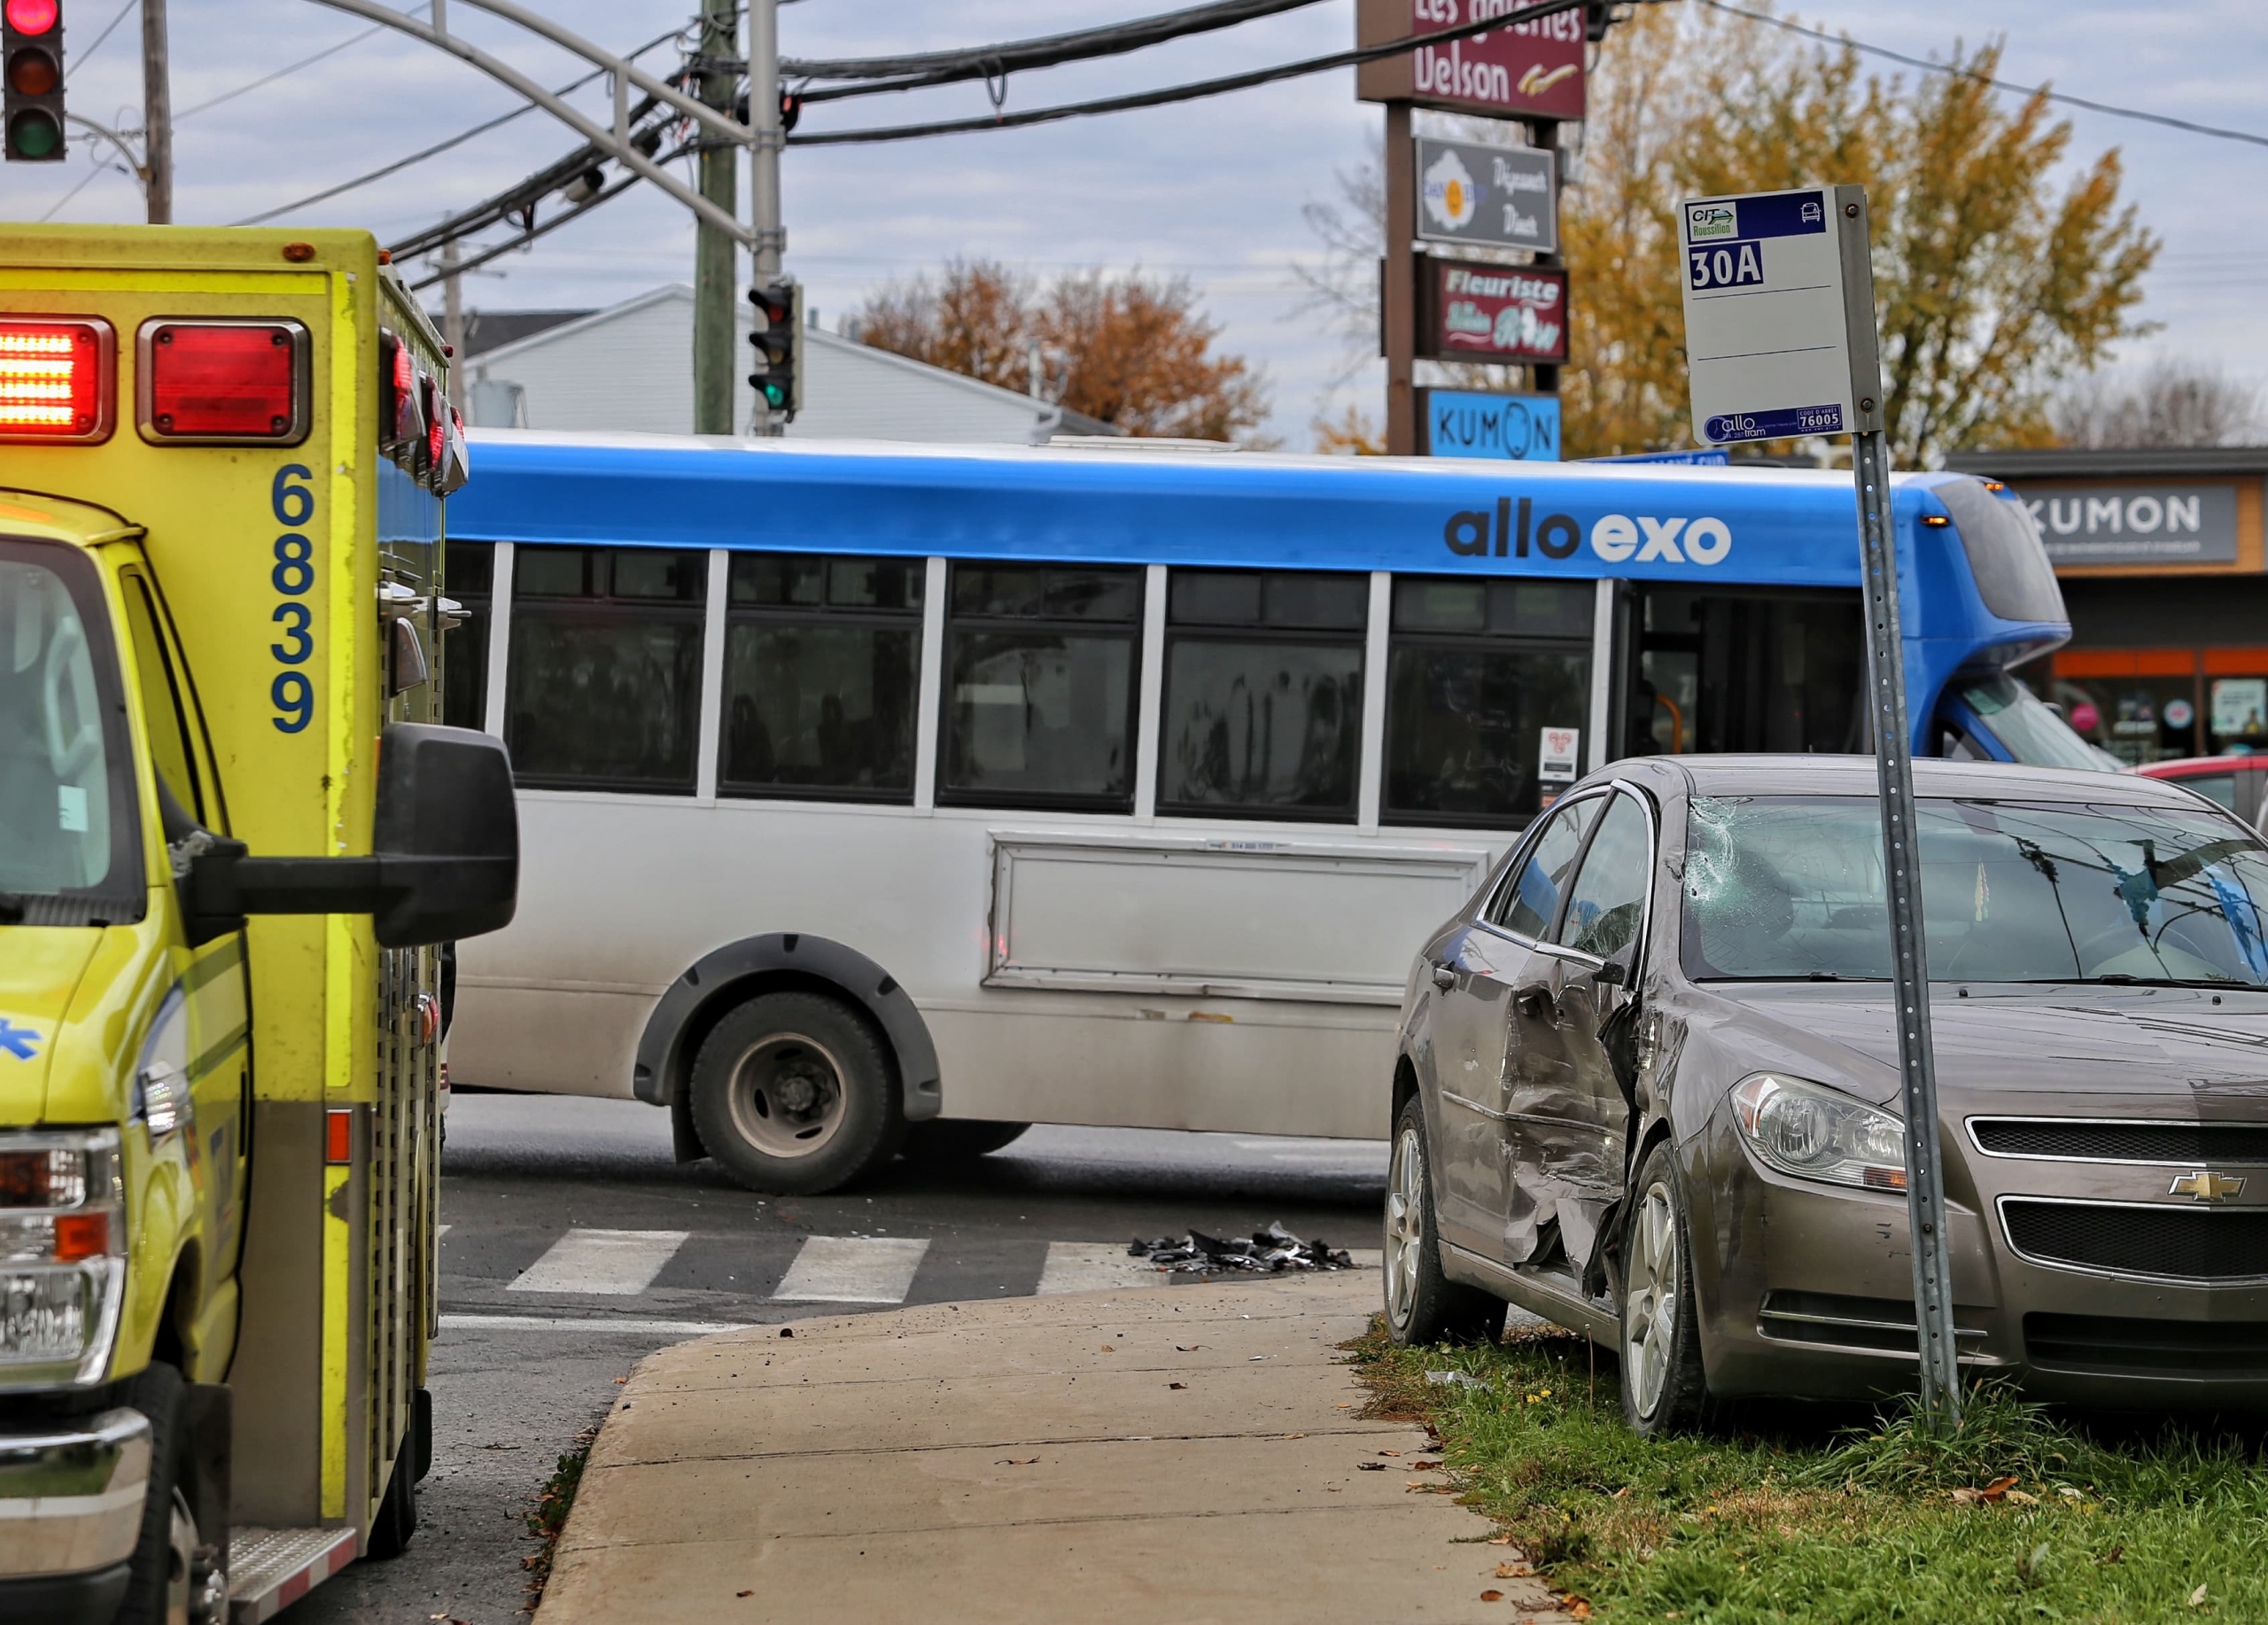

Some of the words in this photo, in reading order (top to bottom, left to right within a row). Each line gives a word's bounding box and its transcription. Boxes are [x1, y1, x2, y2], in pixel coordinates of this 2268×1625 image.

[1415, 39, 1510, 103] Delson
[1692, 208, 1720, 224] CIT
[1693, 223, 1730, 237] Roussillon
[1691, 245, 1761, 287] 30A
[1446, 268, 1559, 301] Fleuriste
[1438, 401, 1553, 460] KUMON
[1721, 415, 1755, 432] allo
[1744, 427, 1766, 438] tram
[1799, 413, 1839, 427] 76005
[1444, 496, 1581, 560] allo
[1590, 513, 1732, 565] exo
[271, 463, 315, 735] 6839
